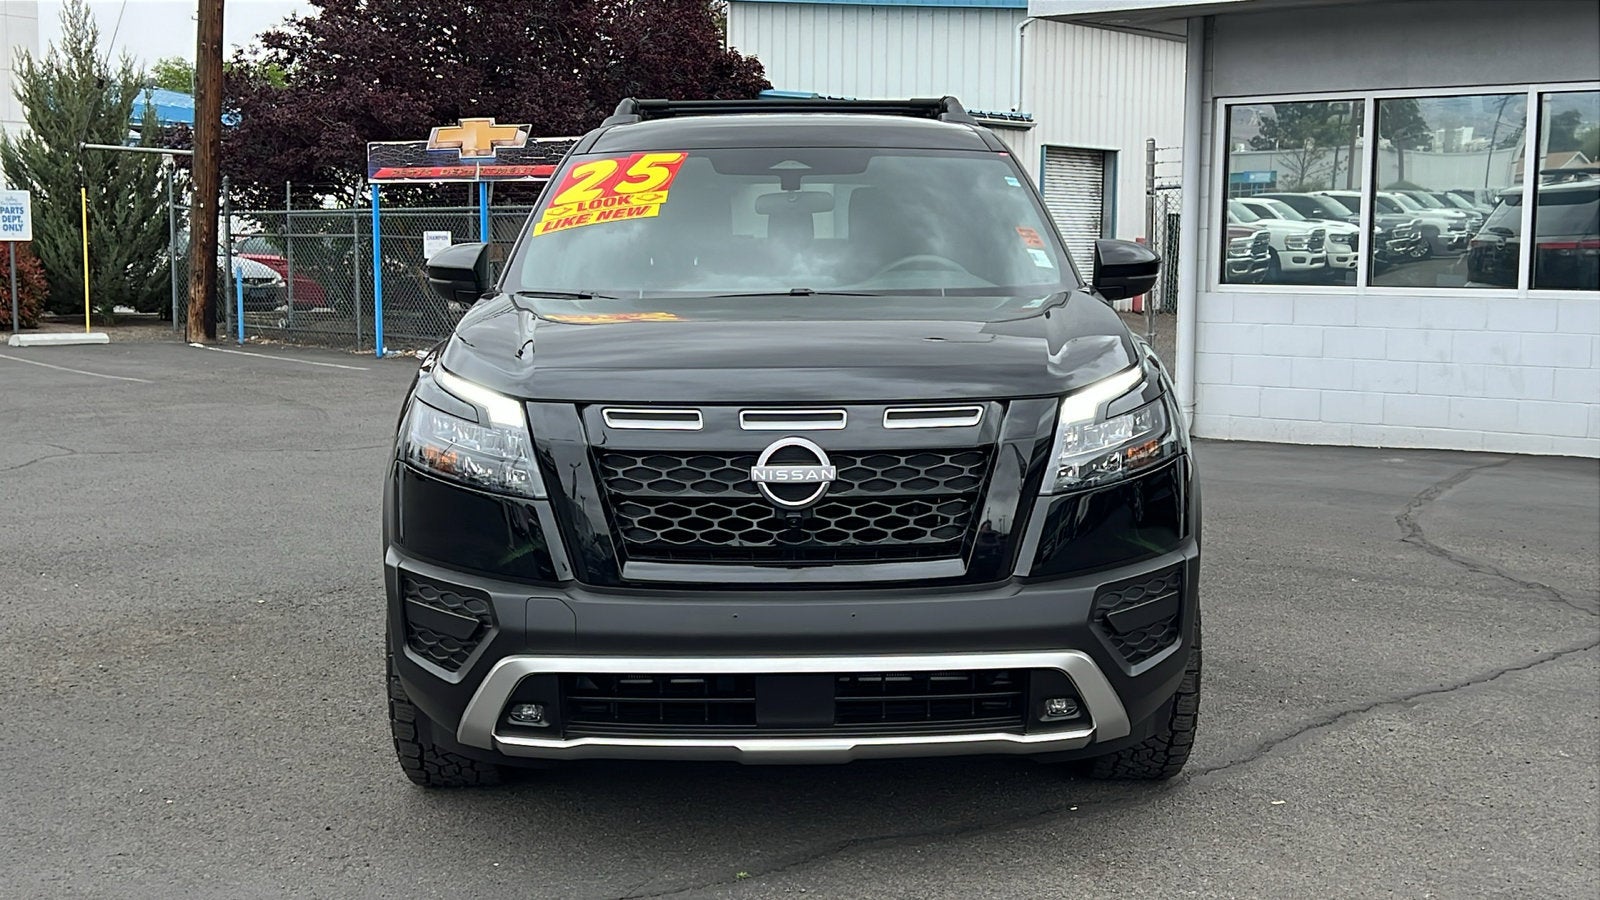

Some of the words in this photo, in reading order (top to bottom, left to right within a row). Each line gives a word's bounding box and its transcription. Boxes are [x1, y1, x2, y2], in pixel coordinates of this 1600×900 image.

[554, 153, 683, 205] 25
[577, 195, 633, 212] LOOK
[0, 206, 24, 214] PARTS
[2, 215, 24, 223] DEPT.
[542, 214, 592, 232] LIKE
[596, 206, 652, 220] NEW
[3, 224, 24, 232] ONLY
[753, 469, 834, 481] NISSAN
